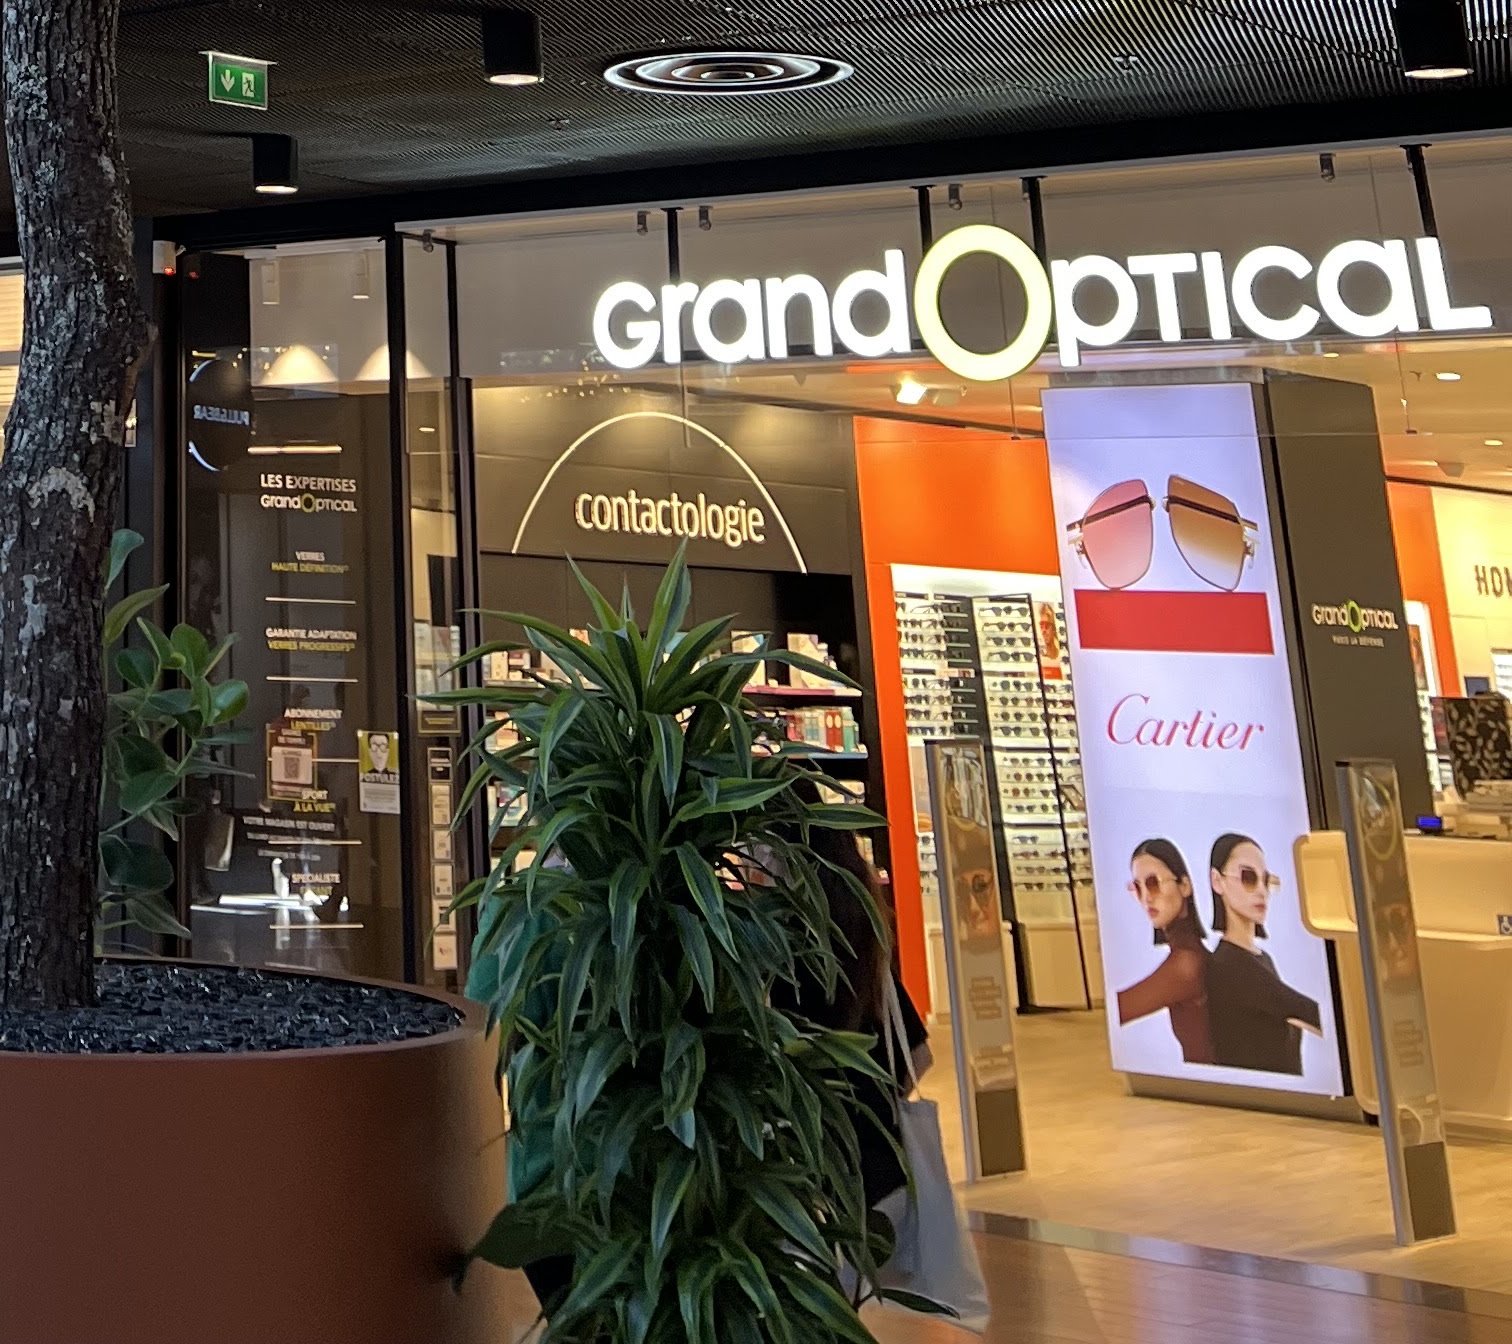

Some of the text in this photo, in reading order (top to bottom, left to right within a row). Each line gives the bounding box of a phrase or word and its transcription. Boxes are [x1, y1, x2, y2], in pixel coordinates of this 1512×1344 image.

[260, 473, 357, 493] LES EXPERTISES
[575, 489, 766, 548] contactologie
[284, 708, 342, 719] ABONNEMENT
[1107, 692, 1265, 751] Cartier
